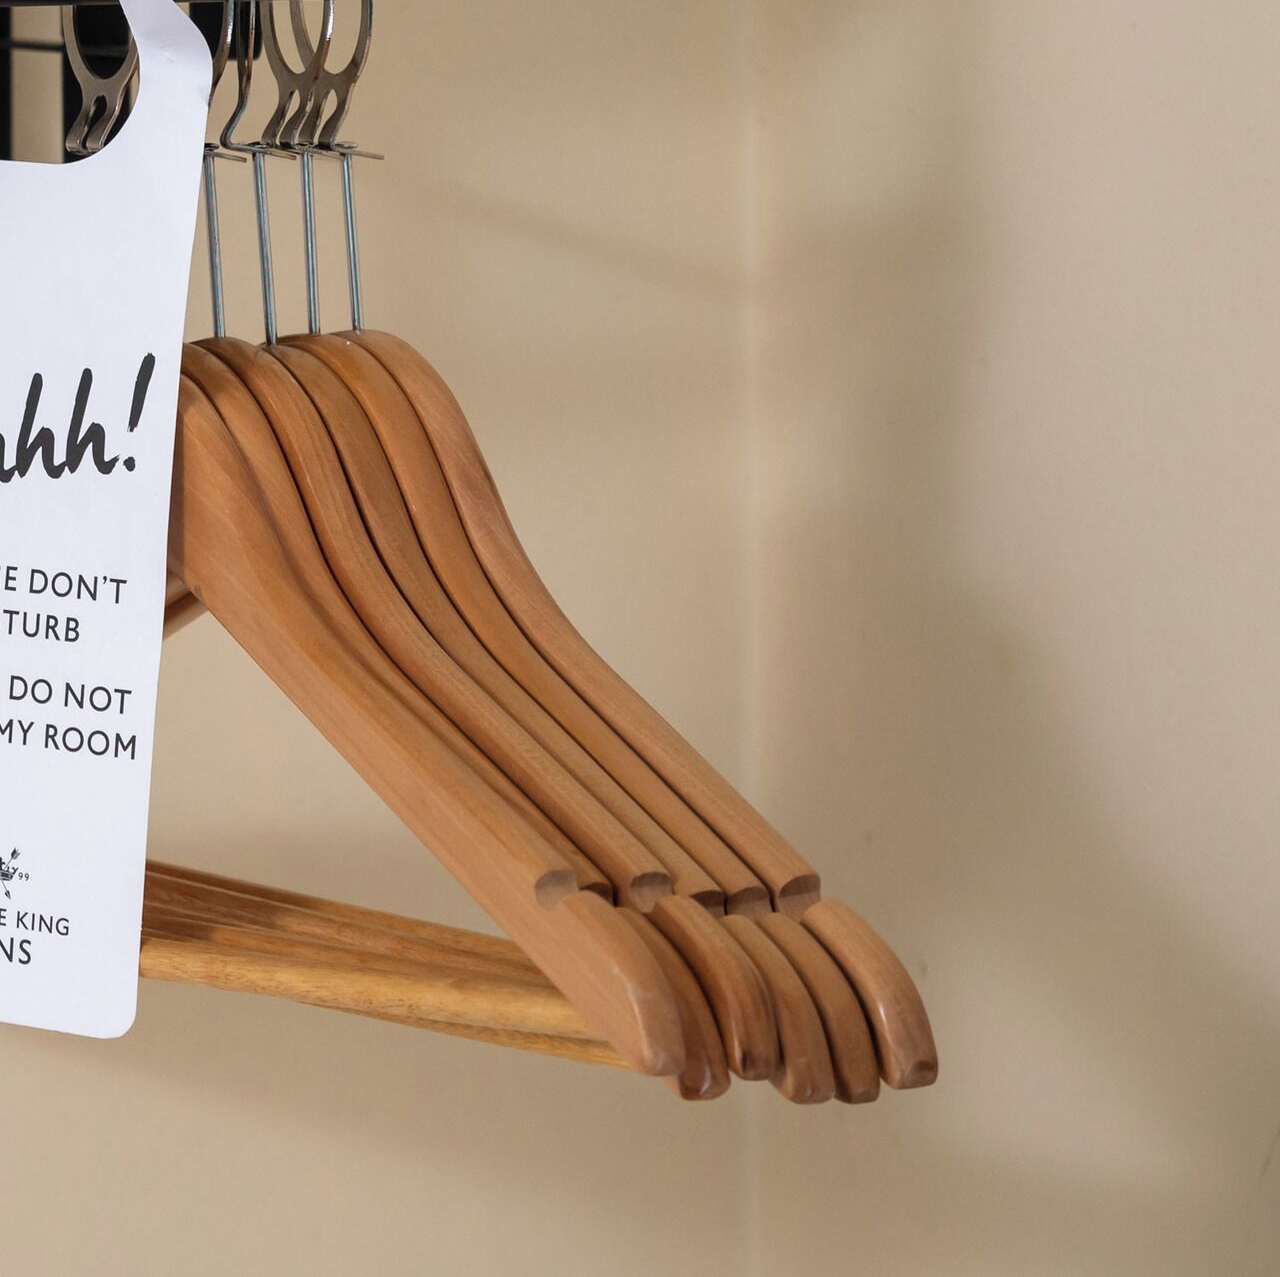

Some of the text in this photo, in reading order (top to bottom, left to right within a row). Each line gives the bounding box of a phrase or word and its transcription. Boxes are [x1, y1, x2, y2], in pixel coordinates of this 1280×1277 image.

[28, 568, 128, 604] DON’T
[8, 674, 53, 705] DO
[64, 682, 133, 715] NOT
[44, 723, 137, 760] ROOM
[16, 910, 70, 936] KING
